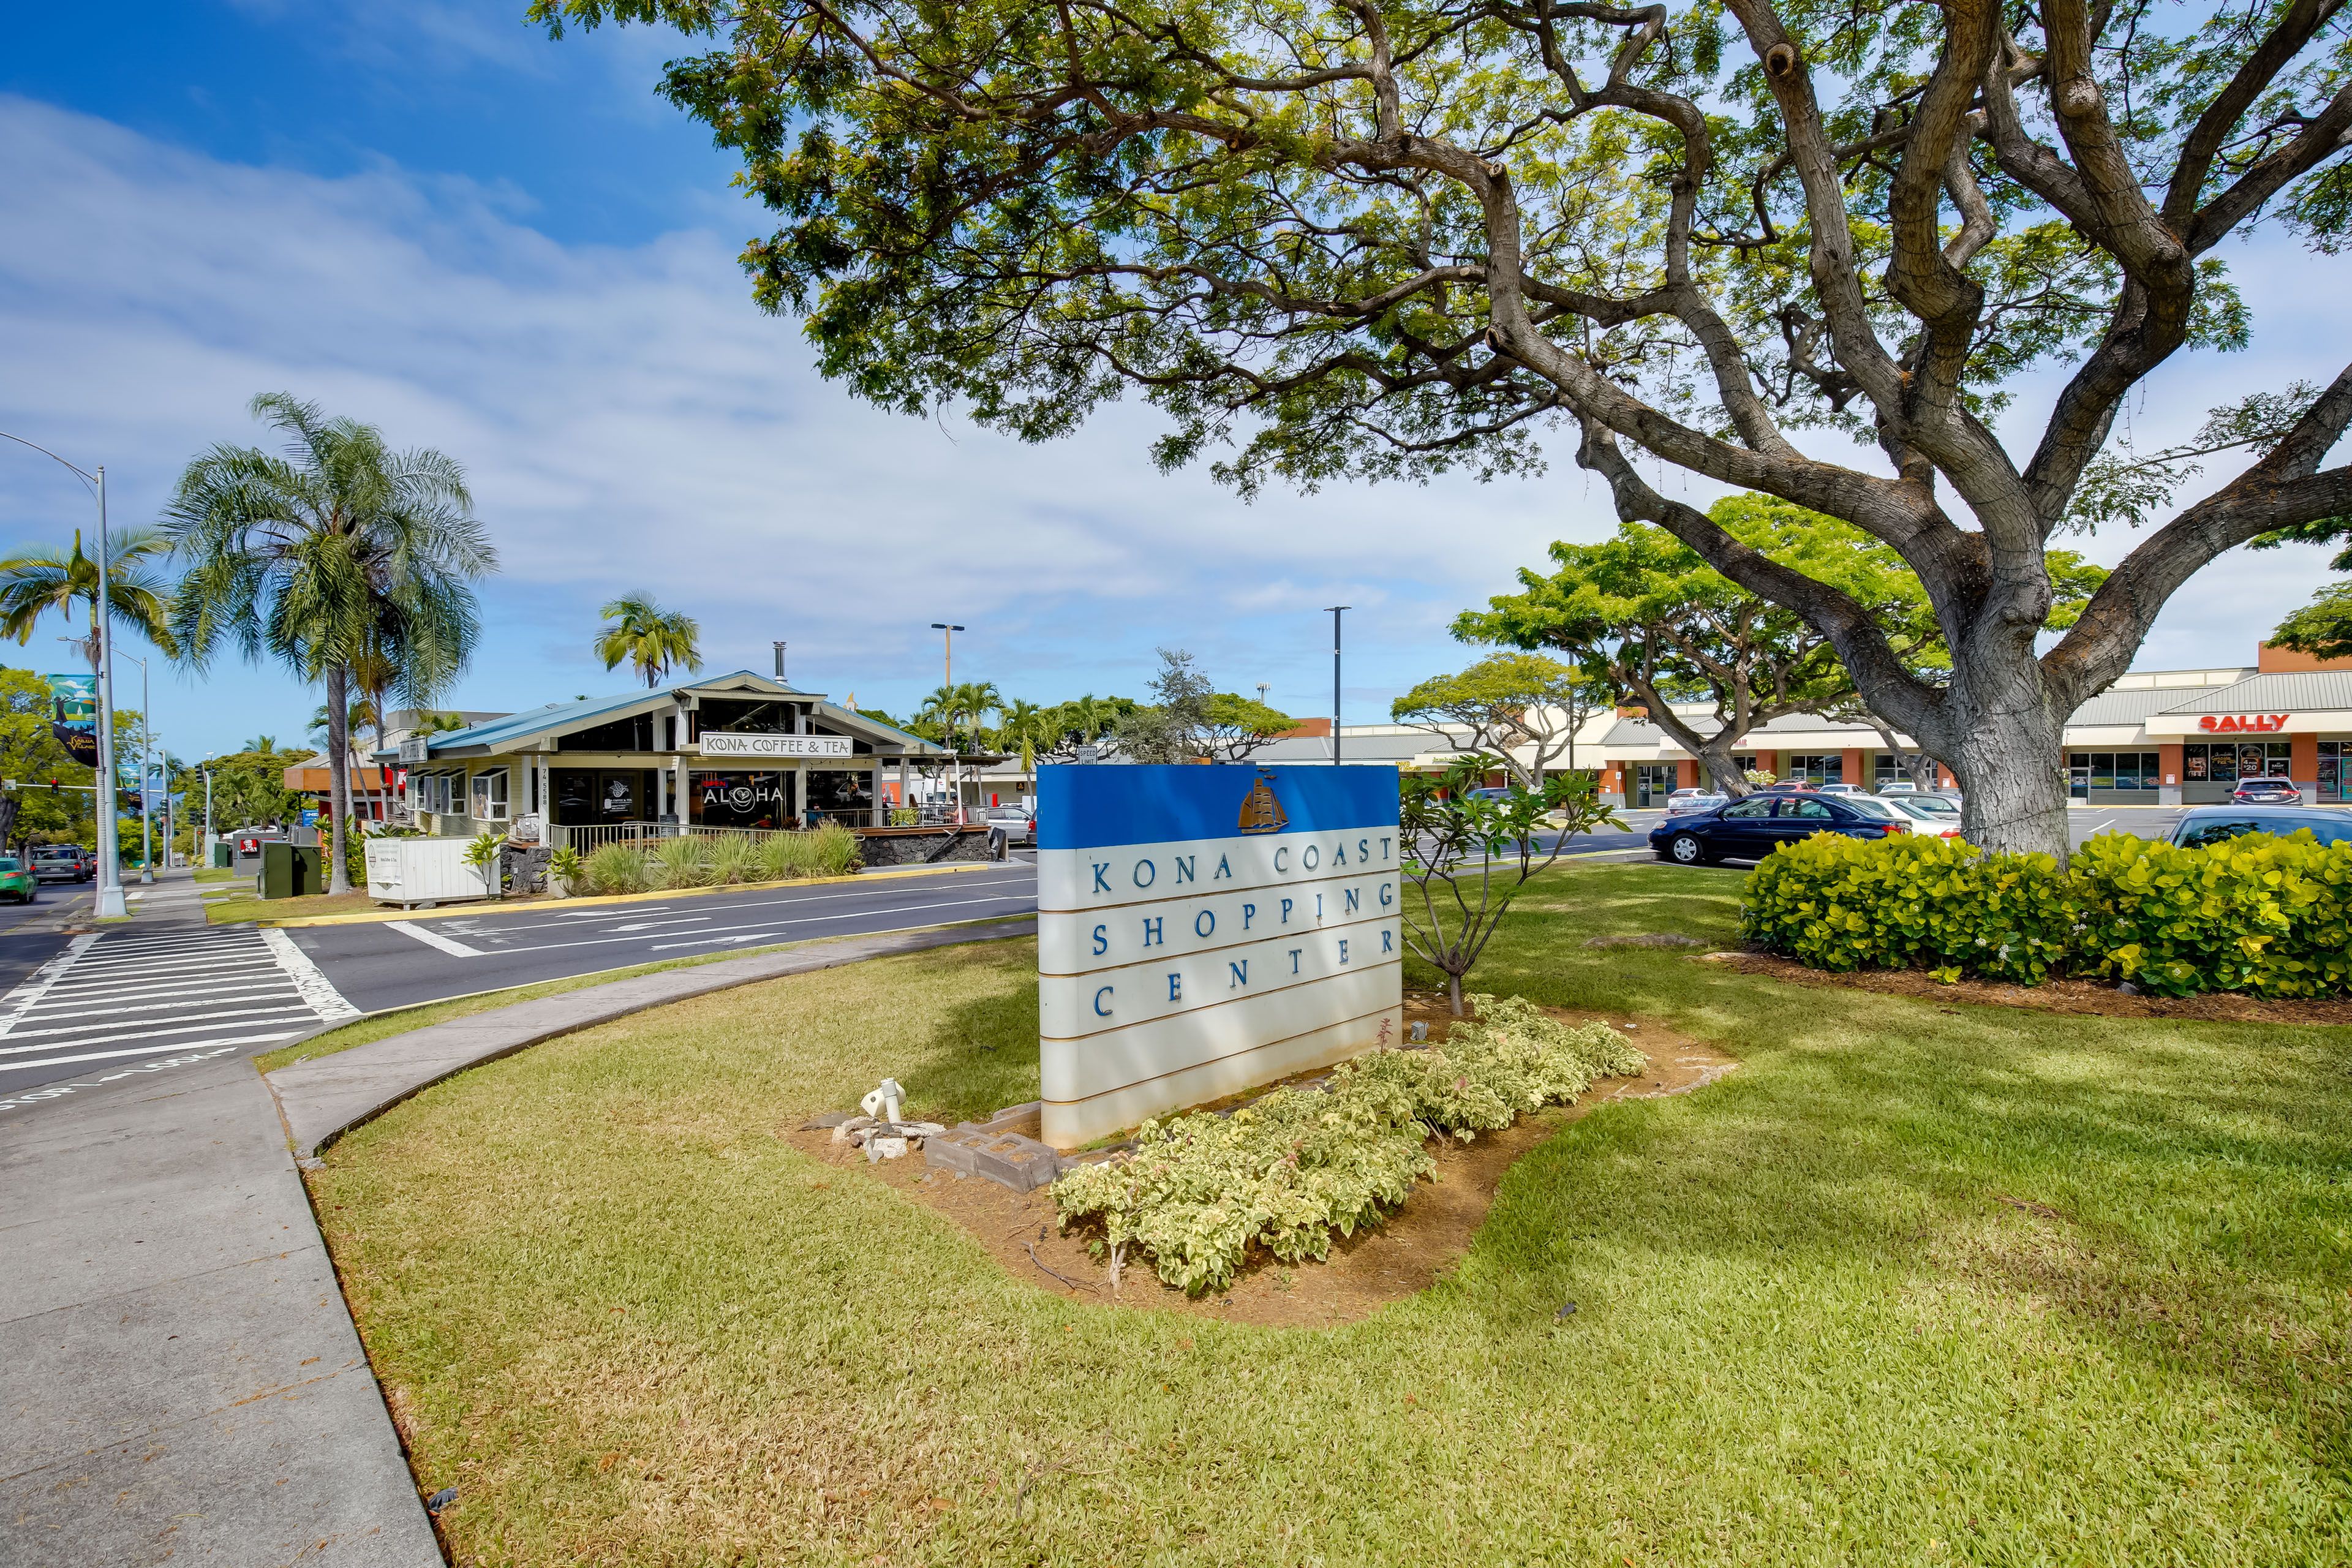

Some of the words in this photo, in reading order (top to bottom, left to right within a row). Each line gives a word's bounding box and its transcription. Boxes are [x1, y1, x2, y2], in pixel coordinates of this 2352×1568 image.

[2199, 714, 2291, 728] SALLY
[705, 737, 748, 752] KONA
[753, 739, 803, 753] COFFEE
[809, 741, 819, 753] &
[824, 741, 849, 753] TEA
[542, 769, 547, 779] 74
[704, 787, 784, 807] ALOHA
[1091, 852, 1233, 894] KONA
[1273, 837, 1392, 872] COAST
[1091, 882, 1393, 956] SHOPPING
[1093, 930, 1393, 1017] CENTER
[123, 1054, 222, 1072] LOOK
